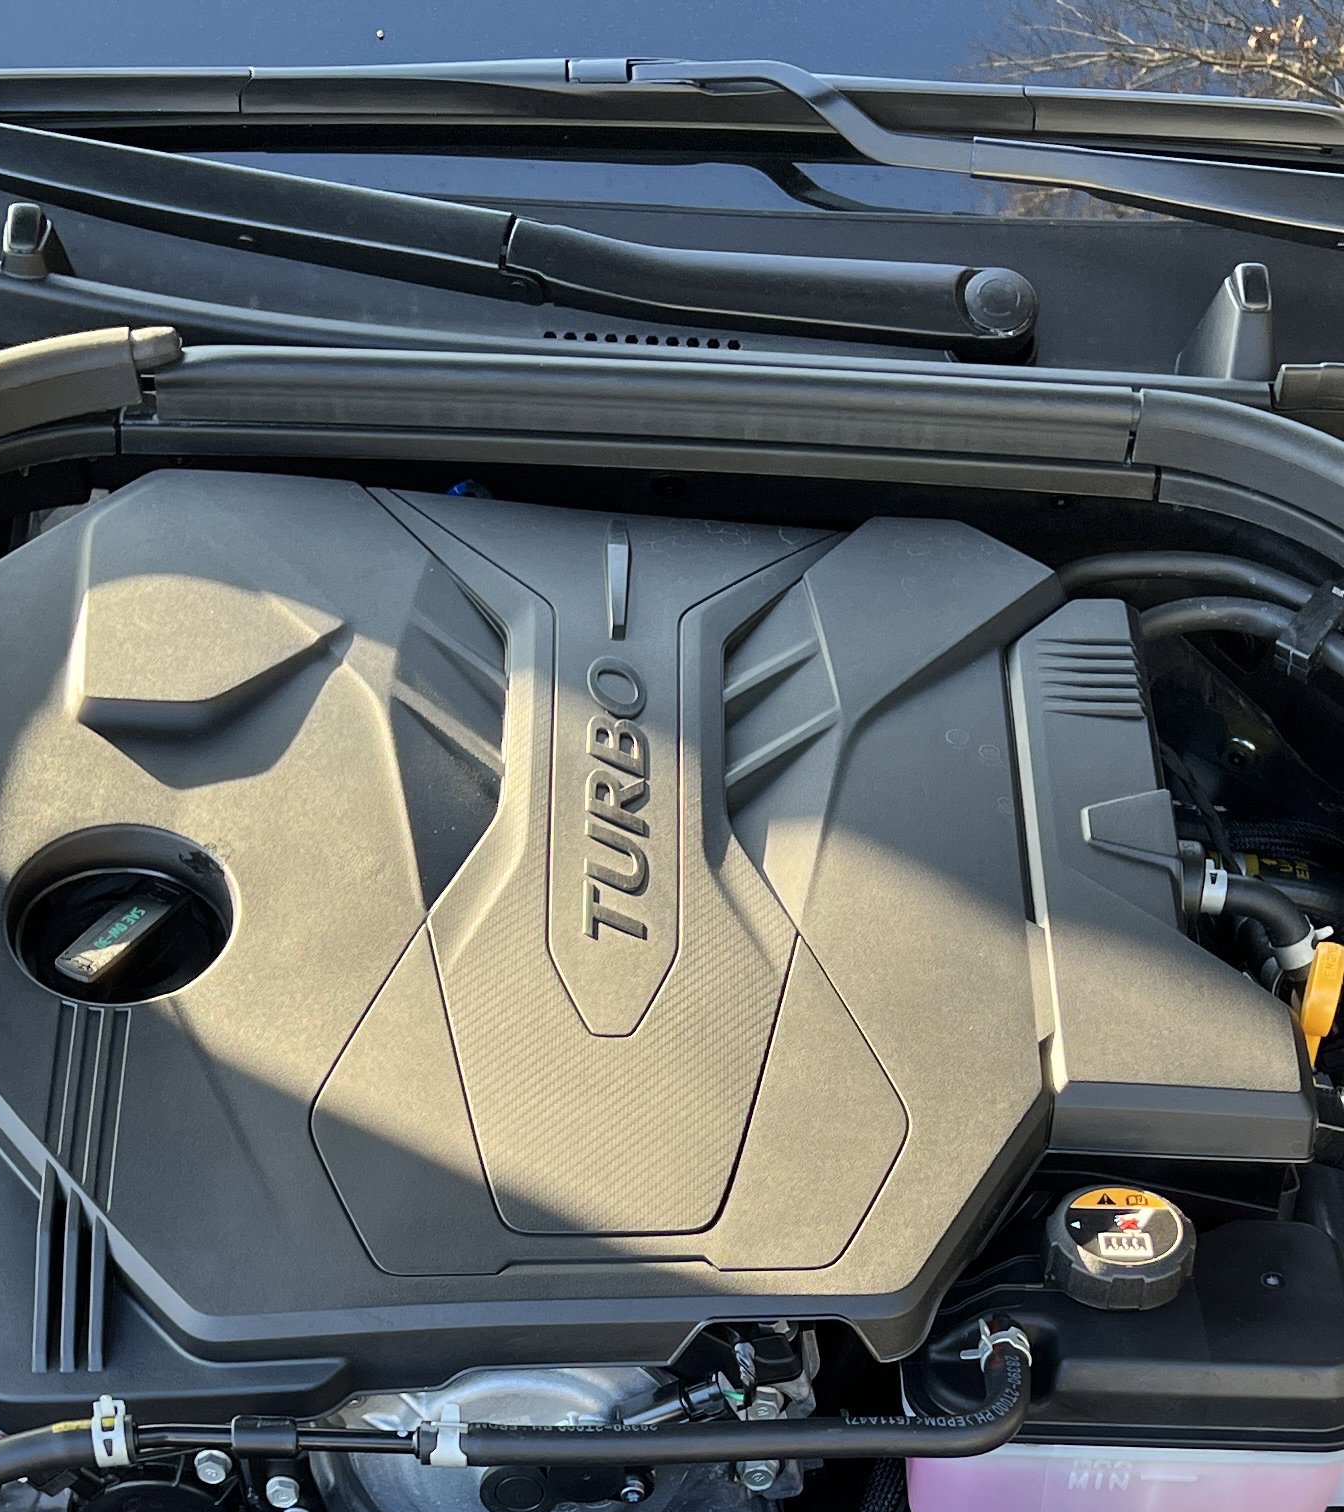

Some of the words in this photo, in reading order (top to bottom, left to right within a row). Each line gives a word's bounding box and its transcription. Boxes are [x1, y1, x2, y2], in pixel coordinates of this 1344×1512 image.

[582, 655, 648, 940] TURBO
[121, 906, 146, 926] SAE
[993, 1354, 1022, 1417] 28390-2T000
[977, 1409, 997, 1424] PH
[1068, 1471, 1130, 1490] MIN
